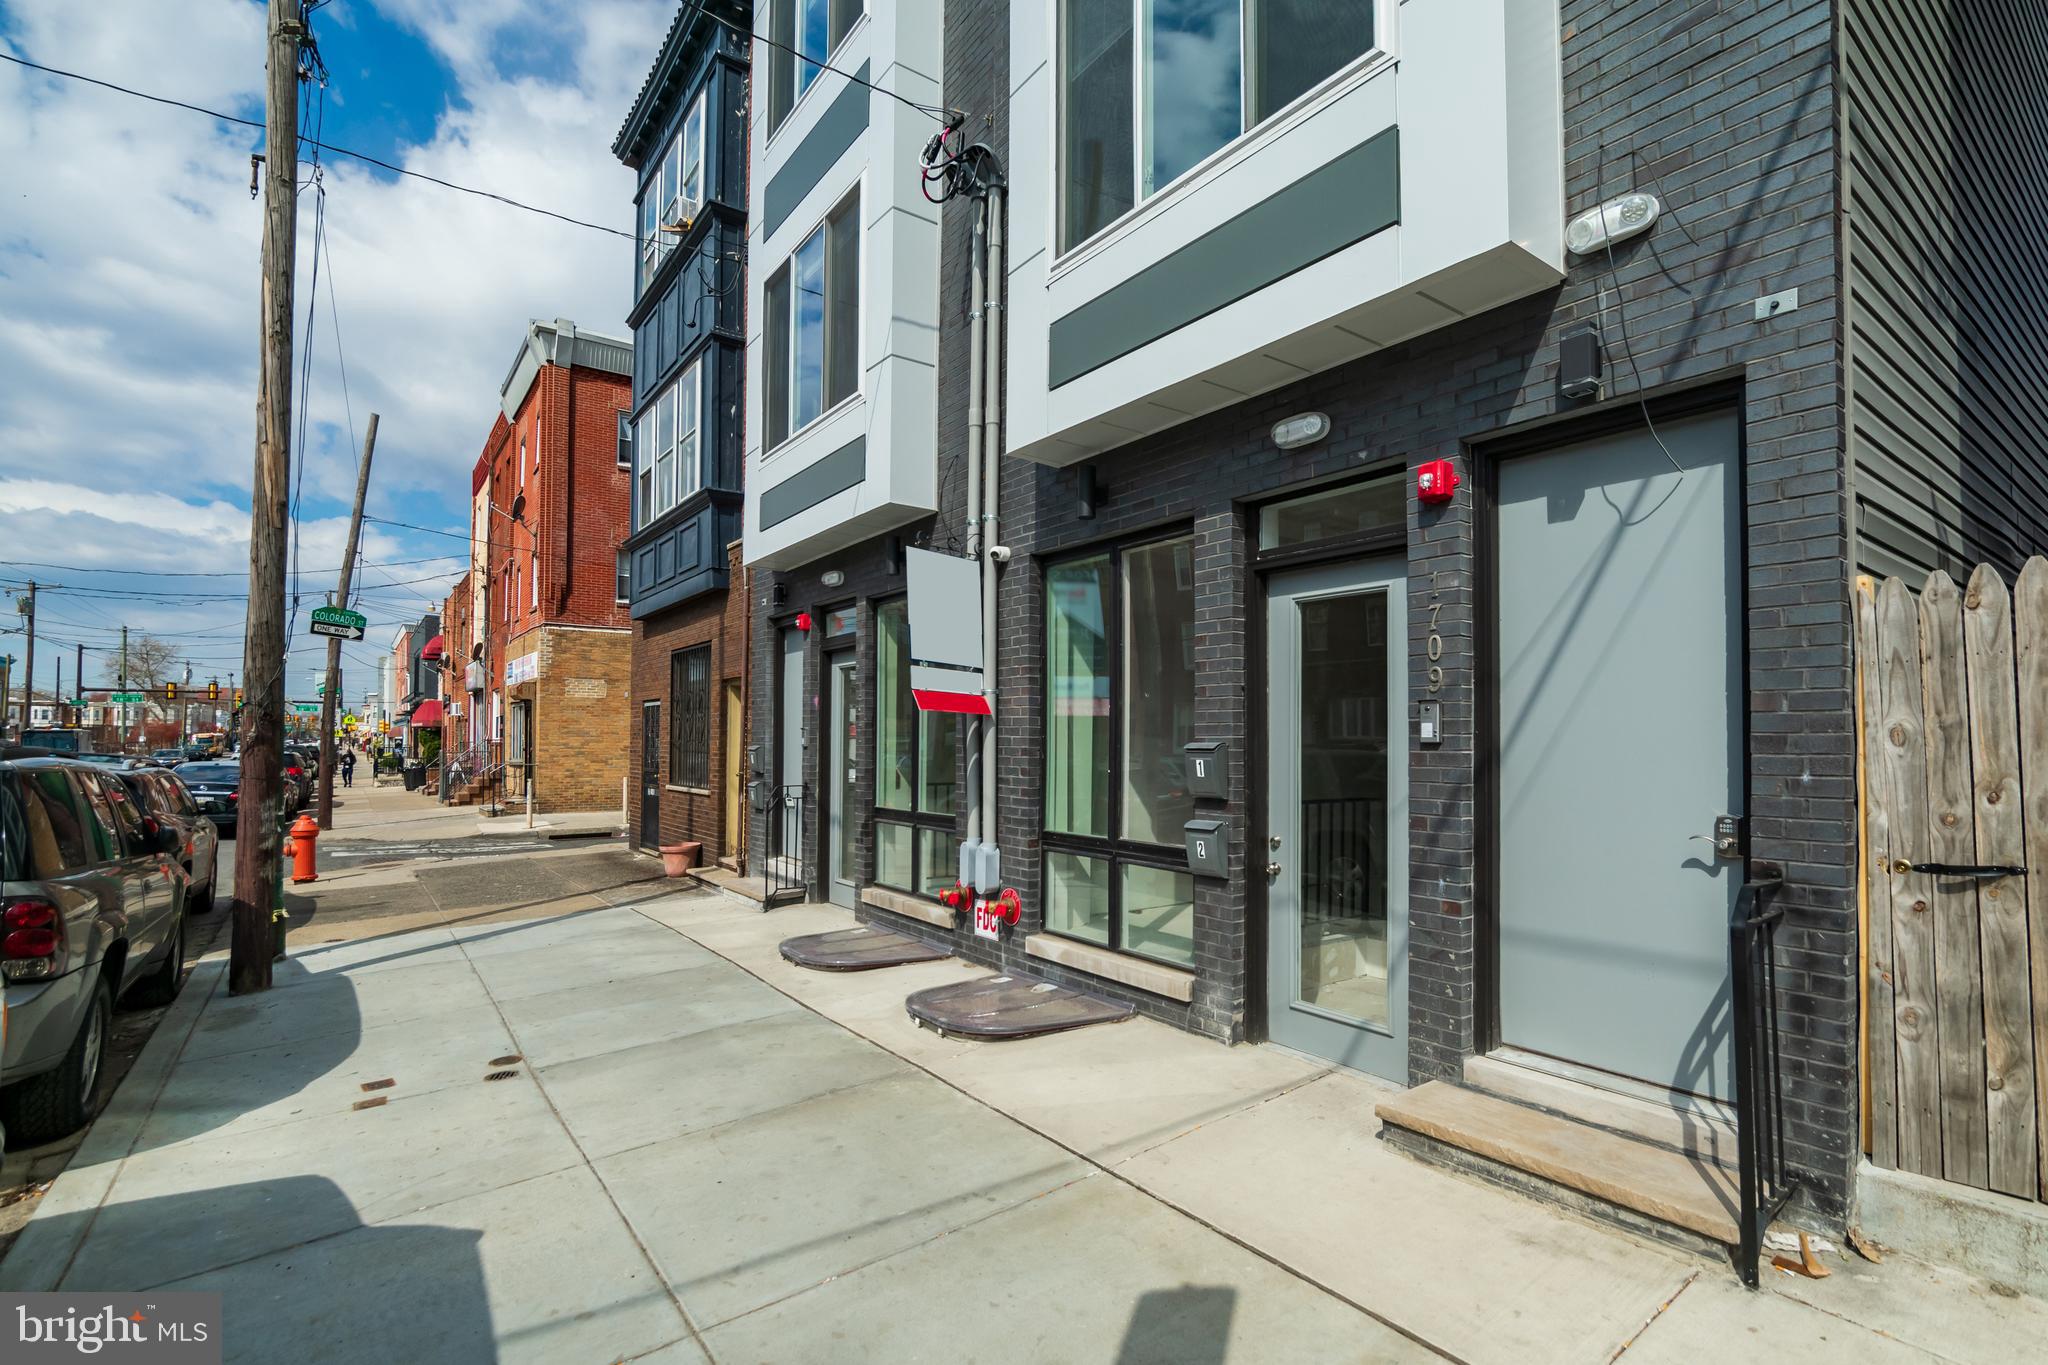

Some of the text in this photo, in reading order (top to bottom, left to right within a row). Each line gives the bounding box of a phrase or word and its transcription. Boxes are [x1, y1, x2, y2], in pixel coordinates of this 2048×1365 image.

[314, 610, 356, 625] COLORADO
[316, 624, 350, 635] ONE WAY
[1428, 571, 1443, 693] 1709
[1198, 842, 1204, 857] 2
[976, 906, 998, 933] FDC
